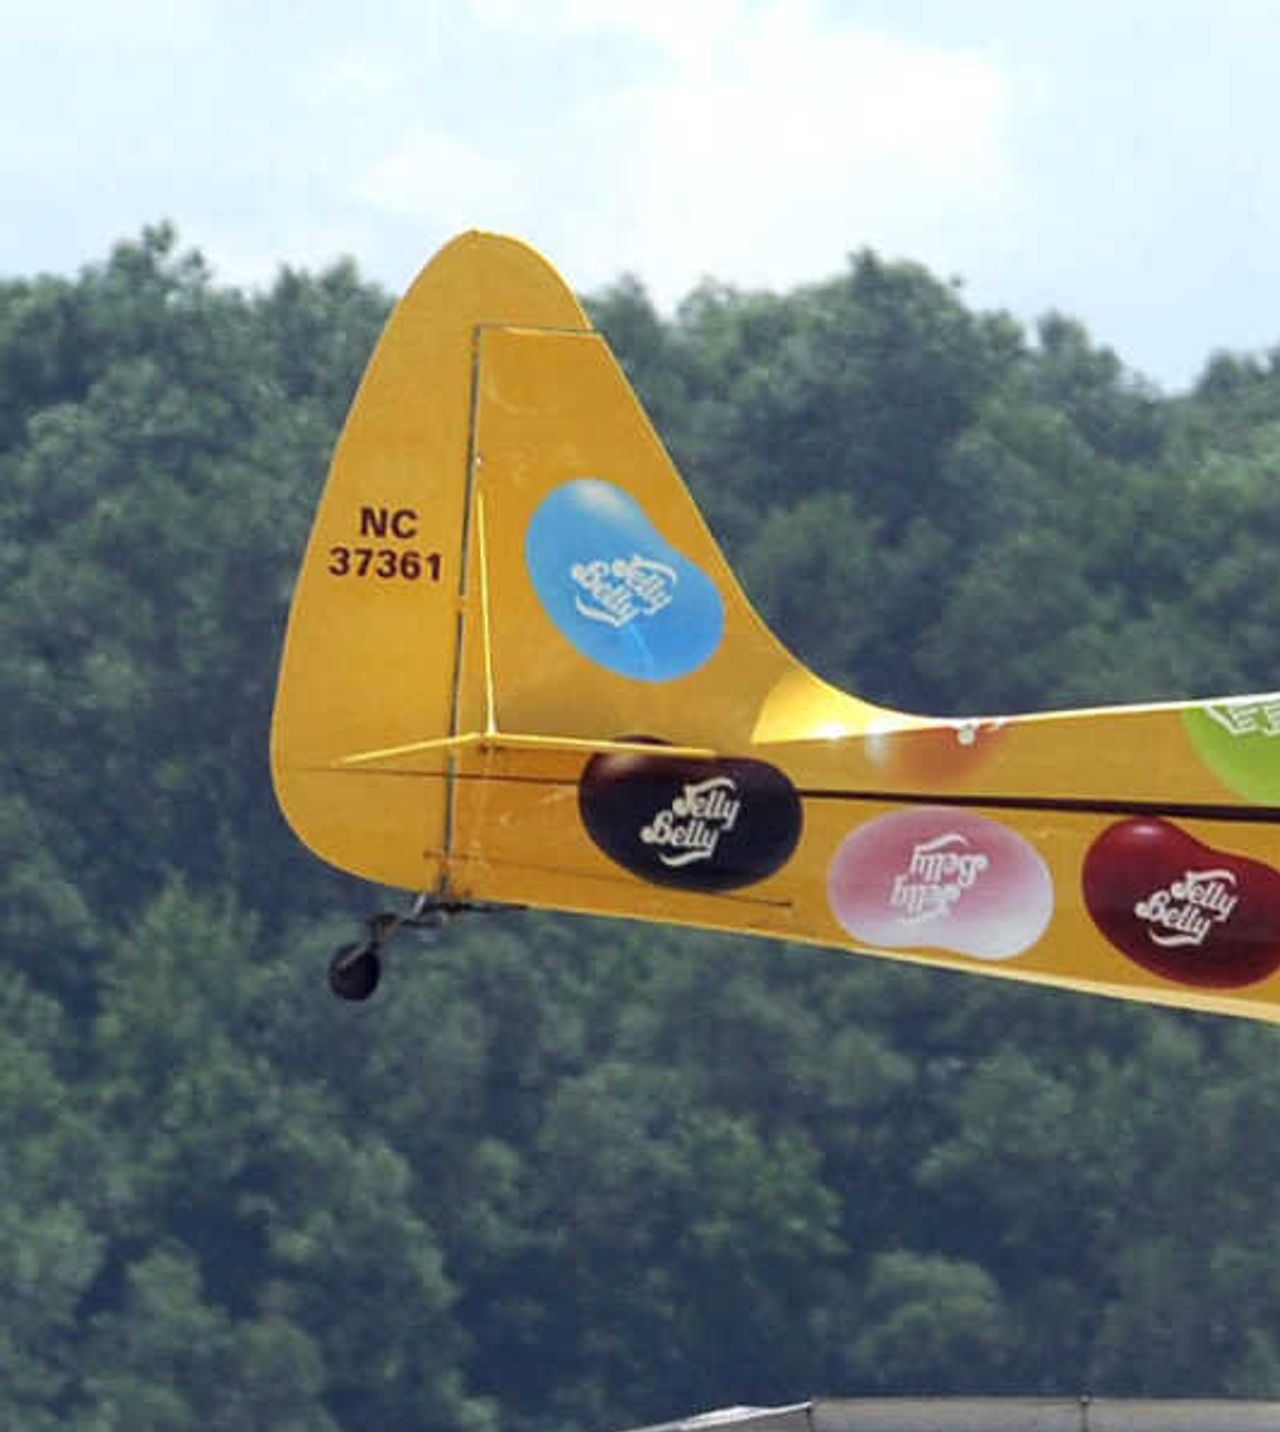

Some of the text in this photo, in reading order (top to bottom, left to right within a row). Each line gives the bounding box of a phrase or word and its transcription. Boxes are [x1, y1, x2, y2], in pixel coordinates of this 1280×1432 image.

[359, 507, 418, 539] NC
[328, 546, 443, 581] 37361
[612, 555, 677, 616] Jelly
[571, 560, 640, 628] Belly
[672, 778, 739, 831] Jelly
[641, 810, 720, 866] Belly
[910, 833, 989, 888] Belly
[889, 874, 961, 924] Jelly
[1134, 890, 1211, 947] Belly
[1171, 869, 1237, 922] Jelly
